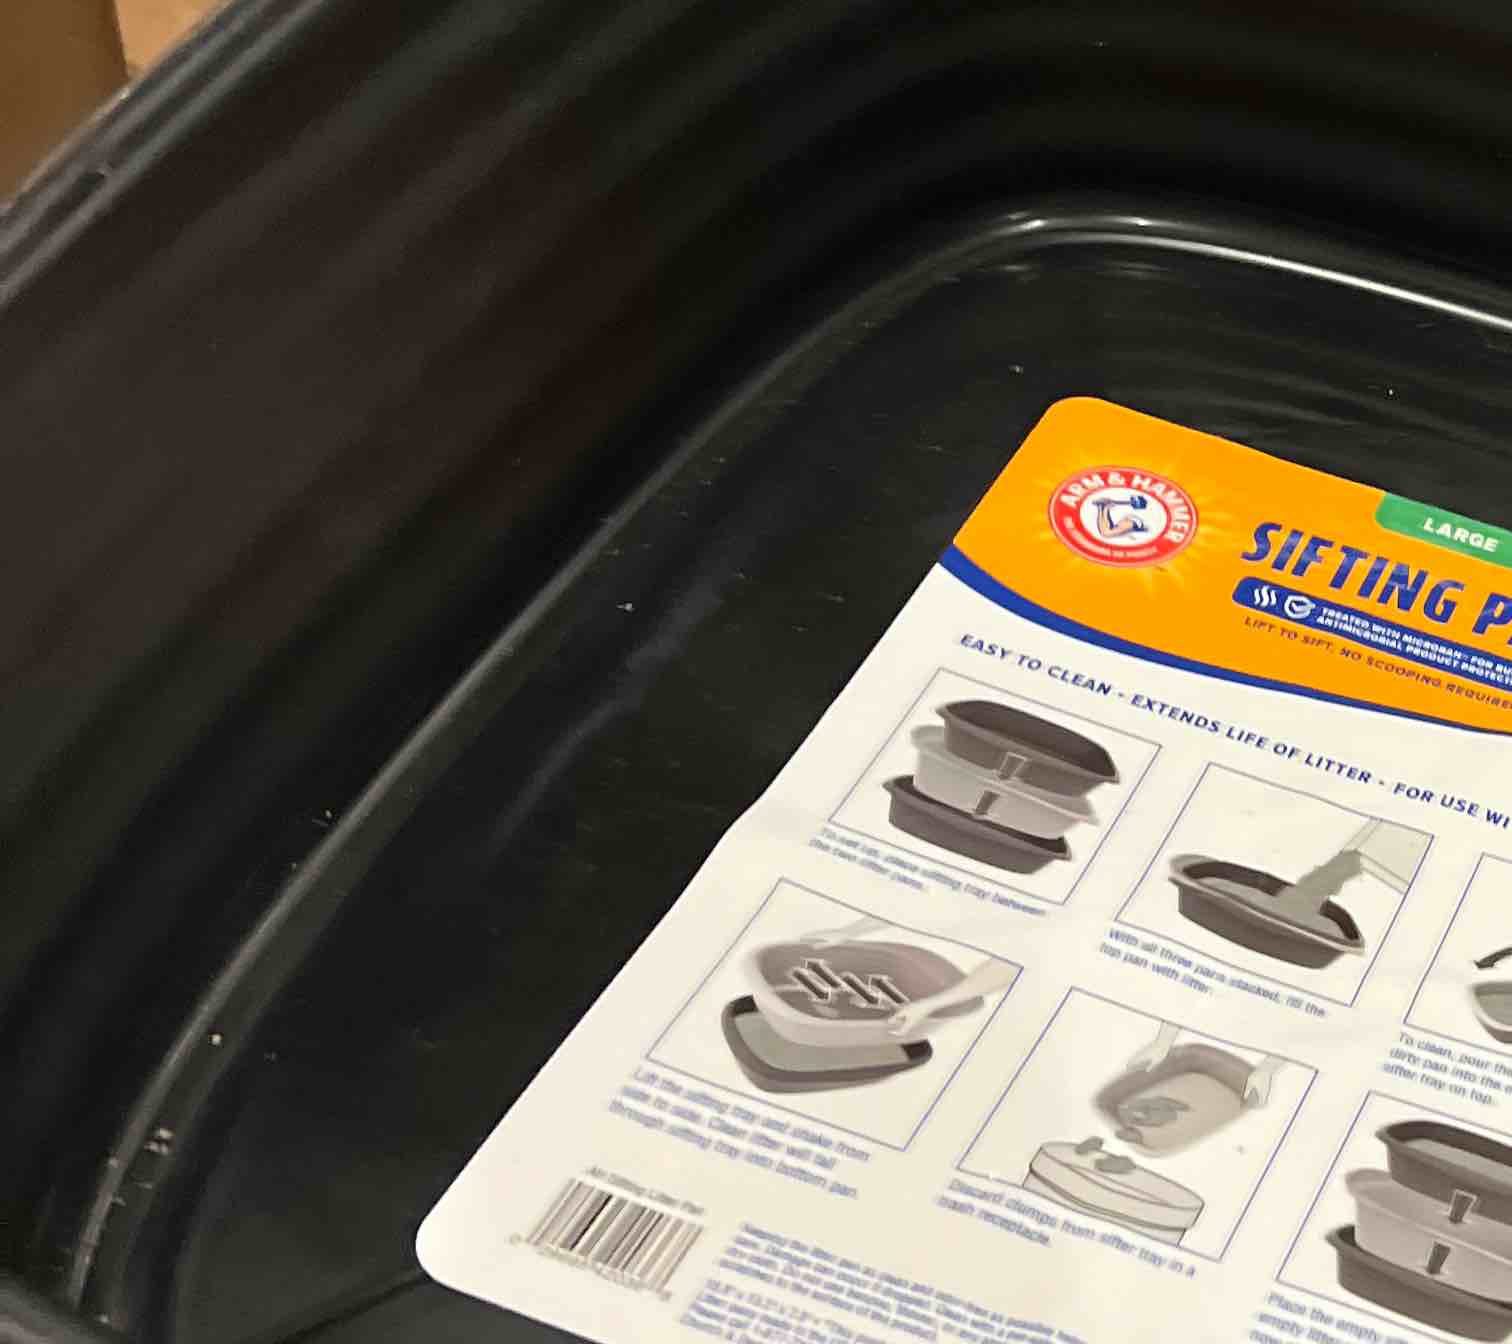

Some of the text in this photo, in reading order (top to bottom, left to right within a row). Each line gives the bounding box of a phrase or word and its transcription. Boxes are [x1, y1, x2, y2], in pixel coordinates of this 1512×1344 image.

[1059, 473, 1104, 508] ARM
[1107, 471, 1126, 486] &
[1131, 474, 1191, 544] HAMMER
[1422, 517, 1500, 554] LARGE
[1240, 520, 1466, 626] SIFTING
[1242, 615, 1276, 634] LIFT
[1277, 626, 1299, 641] TO
[1338, 646, 1362, 663] NO
[1364, 655, 1442, 689] SCOOPING
[1314, 615, 1403, 650] ANTIMICROBIAL
[1404, 643, 1458, 668] PRODUCT
[1320, 607, 1370, 630] TREATED
[1370, 623, 1401, 640] WITH
[1469, 654, 1494, 669] FOR
[957, 632, 1013, 661] EASY
[1013, 651, 1045, 673] TO
[1045, 662, 1113, 697] CLEAN
[1129, 692, 1222, 734] EXTENDS
[1223, 723, 1269, 750] LIFE
[1270, 739, 1302, 761] OF
[1303, 750, 1373, 785] LITTER
[1390, 779, 1435, 804] FOR
[1437, 793, 1480, 818] USE
[1105, 927, 1140, 948] With
[1157, 946, 1194, 971] three
[1302, 1001, 1329, 1019] the
[1122, 949, 1150, 970] pan
[1148, 960, 1181, 982] with
[1417, 1072, 1447, 1092] tray
[1420, 1056, 1450, 1076] pan
[1449, 1065, 1478, 1085] into
[1478, 1073, 1503, 1092] the
[947, 1177, 1005, 1206] Discard
[1003, 1195, 1060, 1228] clumps
[1255, 1307, 1306, 1338] empty
[1263, 1290, 1308, 1318] Place
[1306, 1305, 1335, 1328] the
[1334, 1315, 1383, 1344] empty
